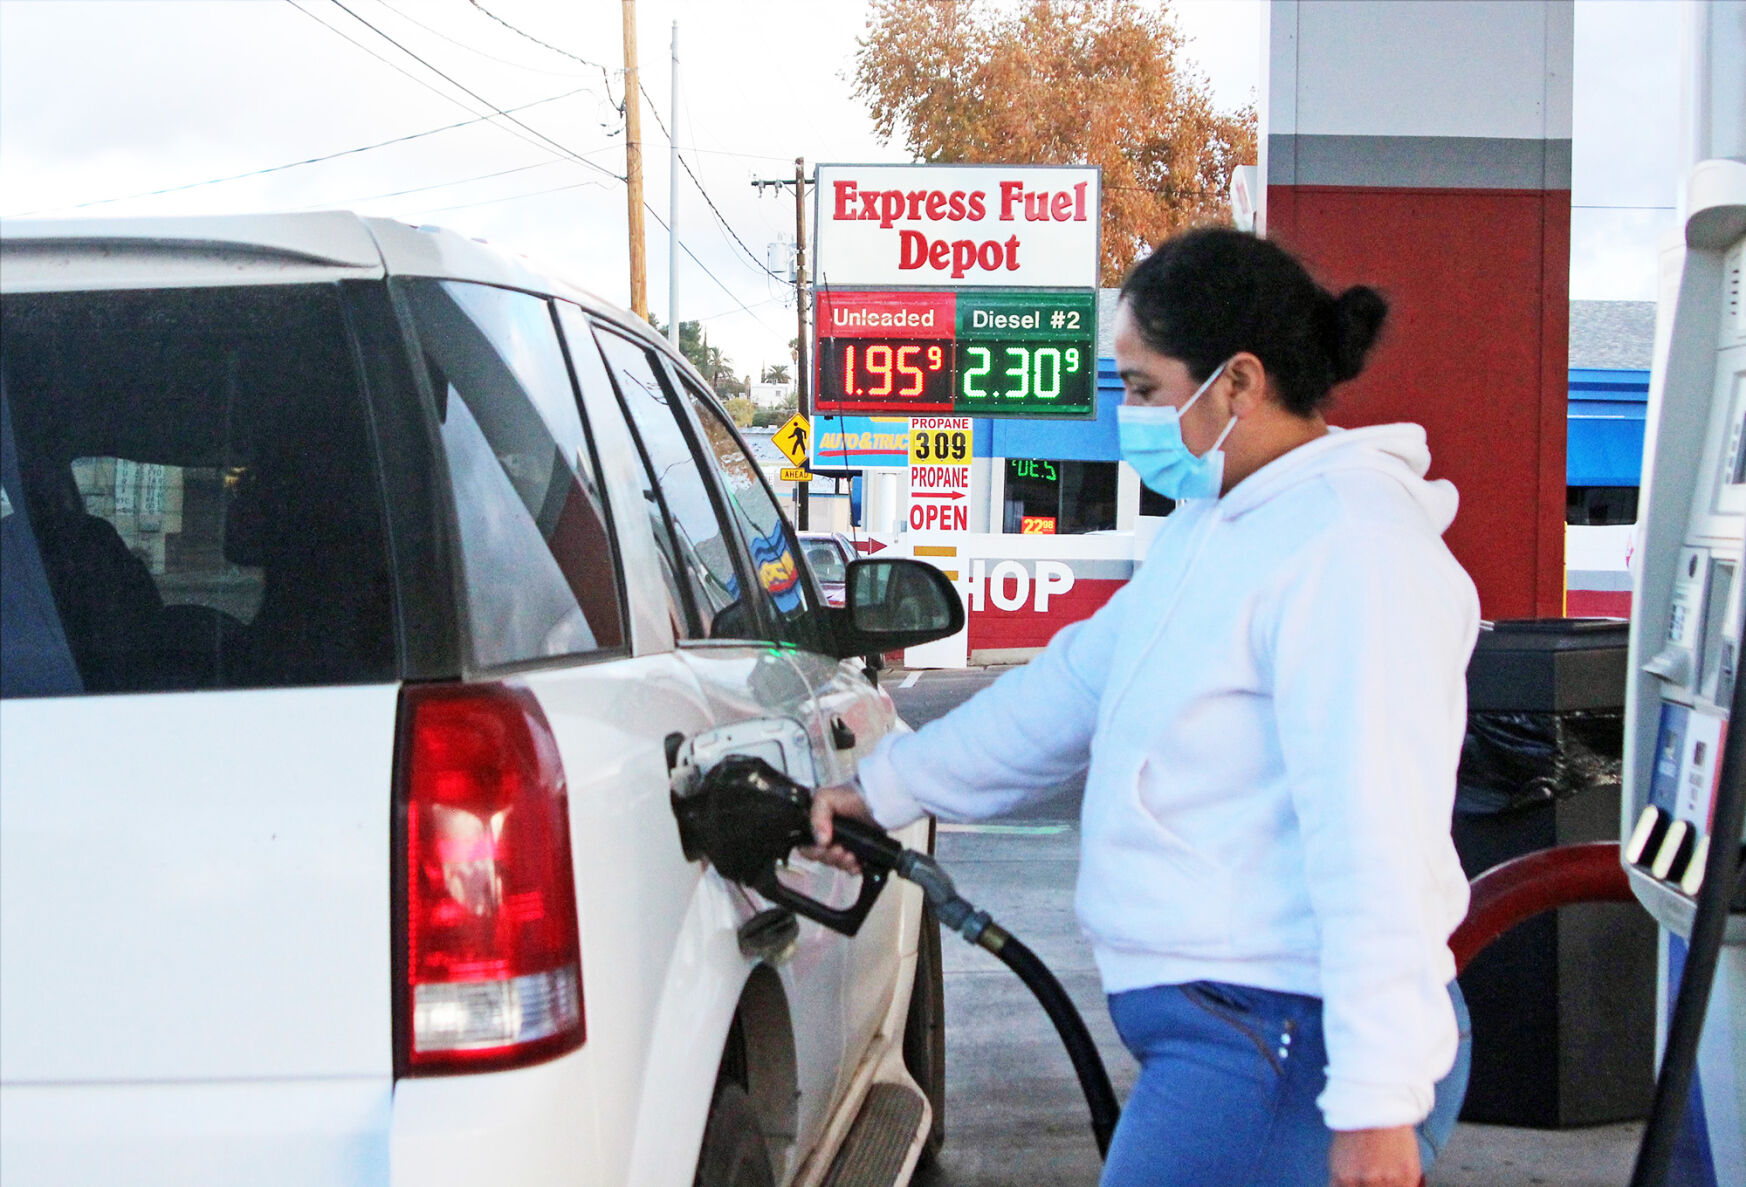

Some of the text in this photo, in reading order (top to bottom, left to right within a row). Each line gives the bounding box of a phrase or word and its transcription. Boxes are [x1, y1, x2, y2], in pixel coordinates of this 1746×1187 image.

[833, 180, 1088, 229] Express Fuel
[898, 230, 1021, 279] Depot
[833, 308, 935, 328] Unleaded
[973, 310, 1081, 329] Diesel #2
[911, 418, 969, 429] PROPANE
[915, 432, 967, 460] 309
[784, 469, 809, 479] AHEAD
[911, 466, 969, 488] PROPANE
[909, 504, 968, 531] OPEN
